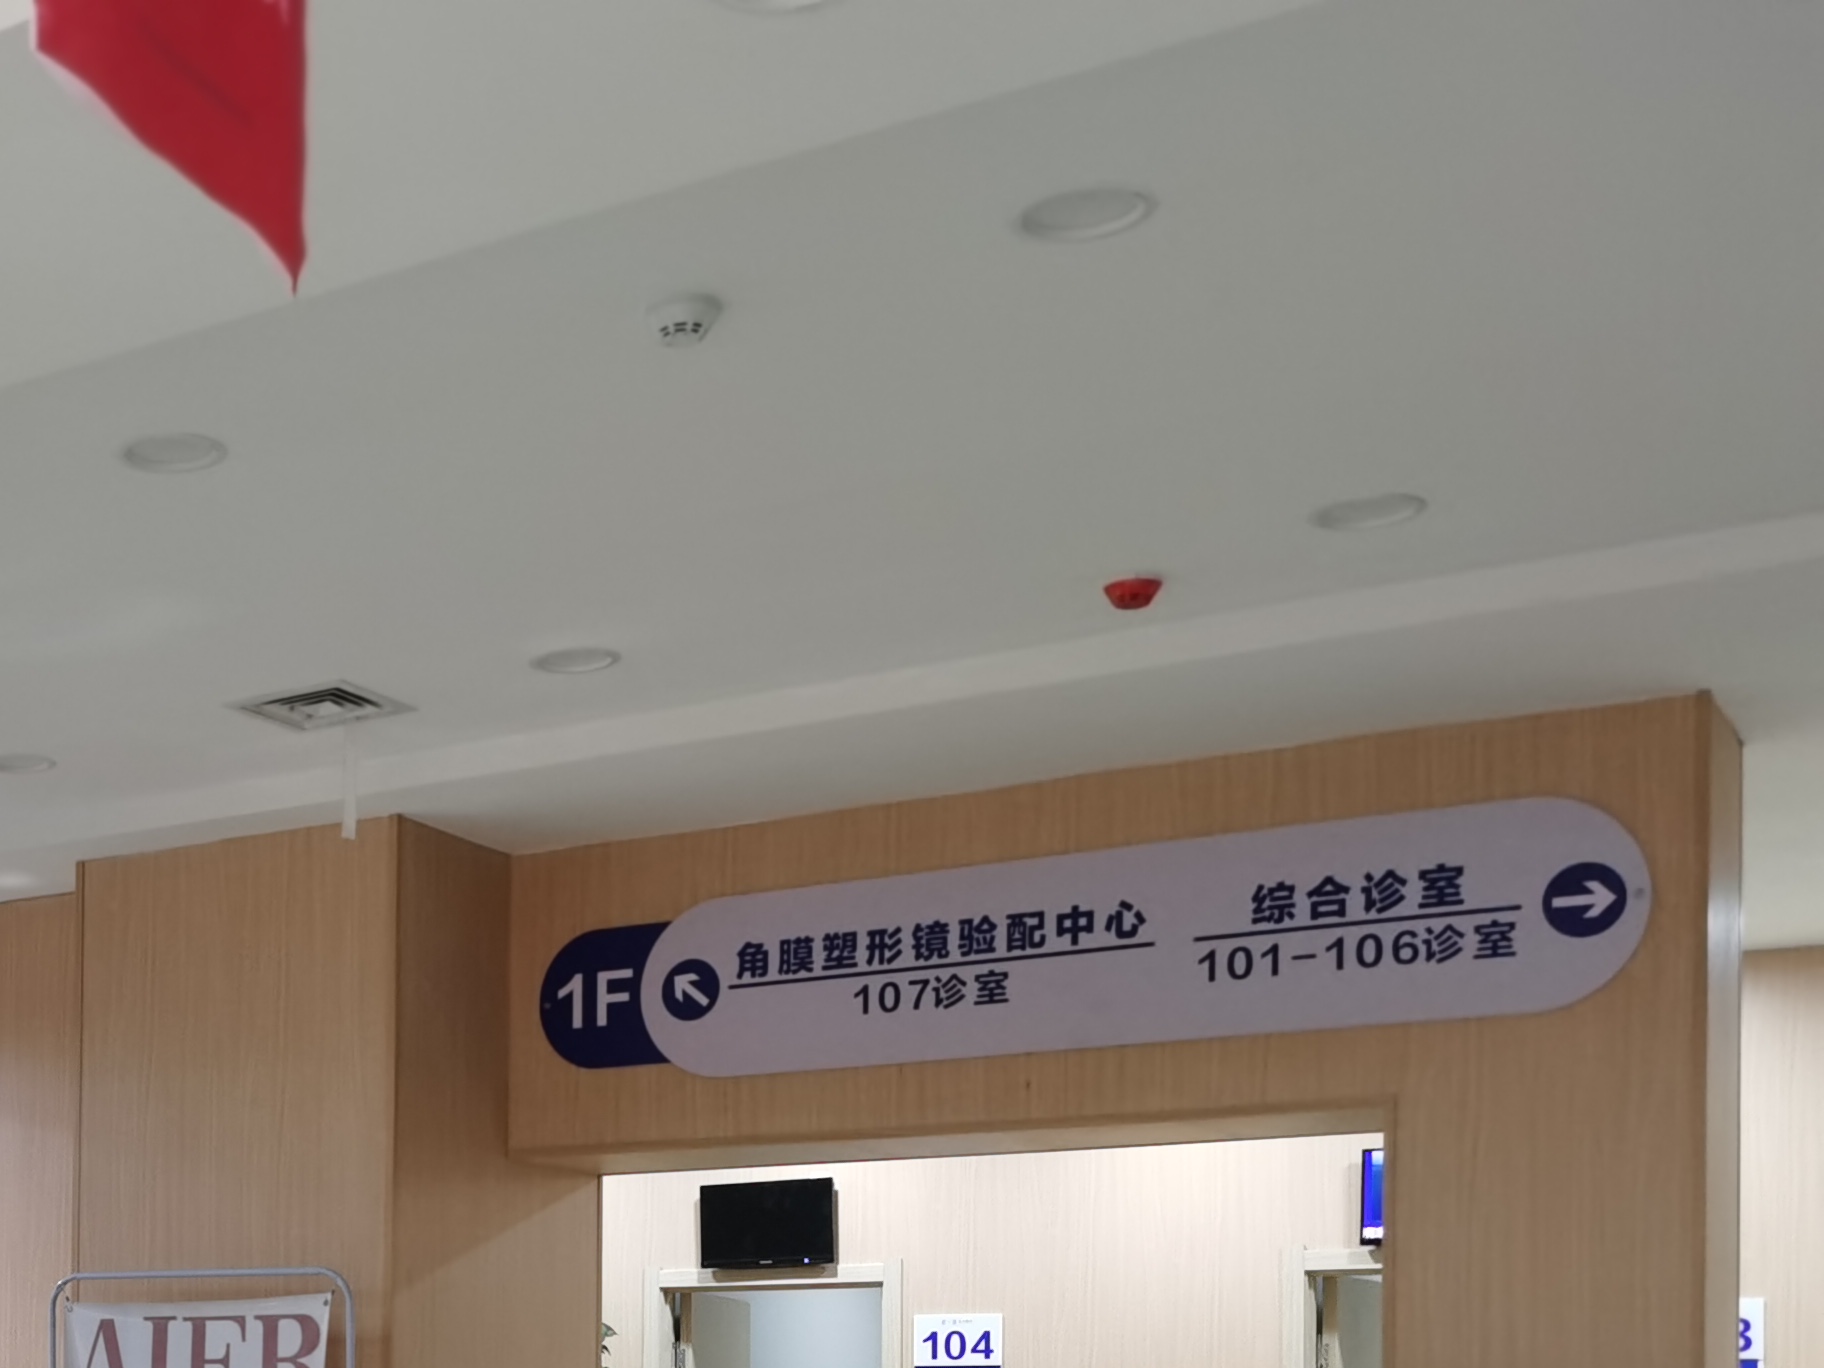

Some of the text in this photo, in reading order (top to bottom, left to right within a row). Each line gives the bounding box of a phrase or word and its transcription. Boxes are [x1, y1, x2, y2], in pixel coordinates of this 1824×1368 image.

[1250, 863, 1466, 925] 综合诊室
[736, 901, 1146, 980] 角膜塑形镜验配中心
[1196, 920, 1517, 983] 101-106诊室
[557, 968, 634, 1029] 1F
[854, 970, 1010, 1015] 107诊室
[922, 1330, 994, 1360] 104
